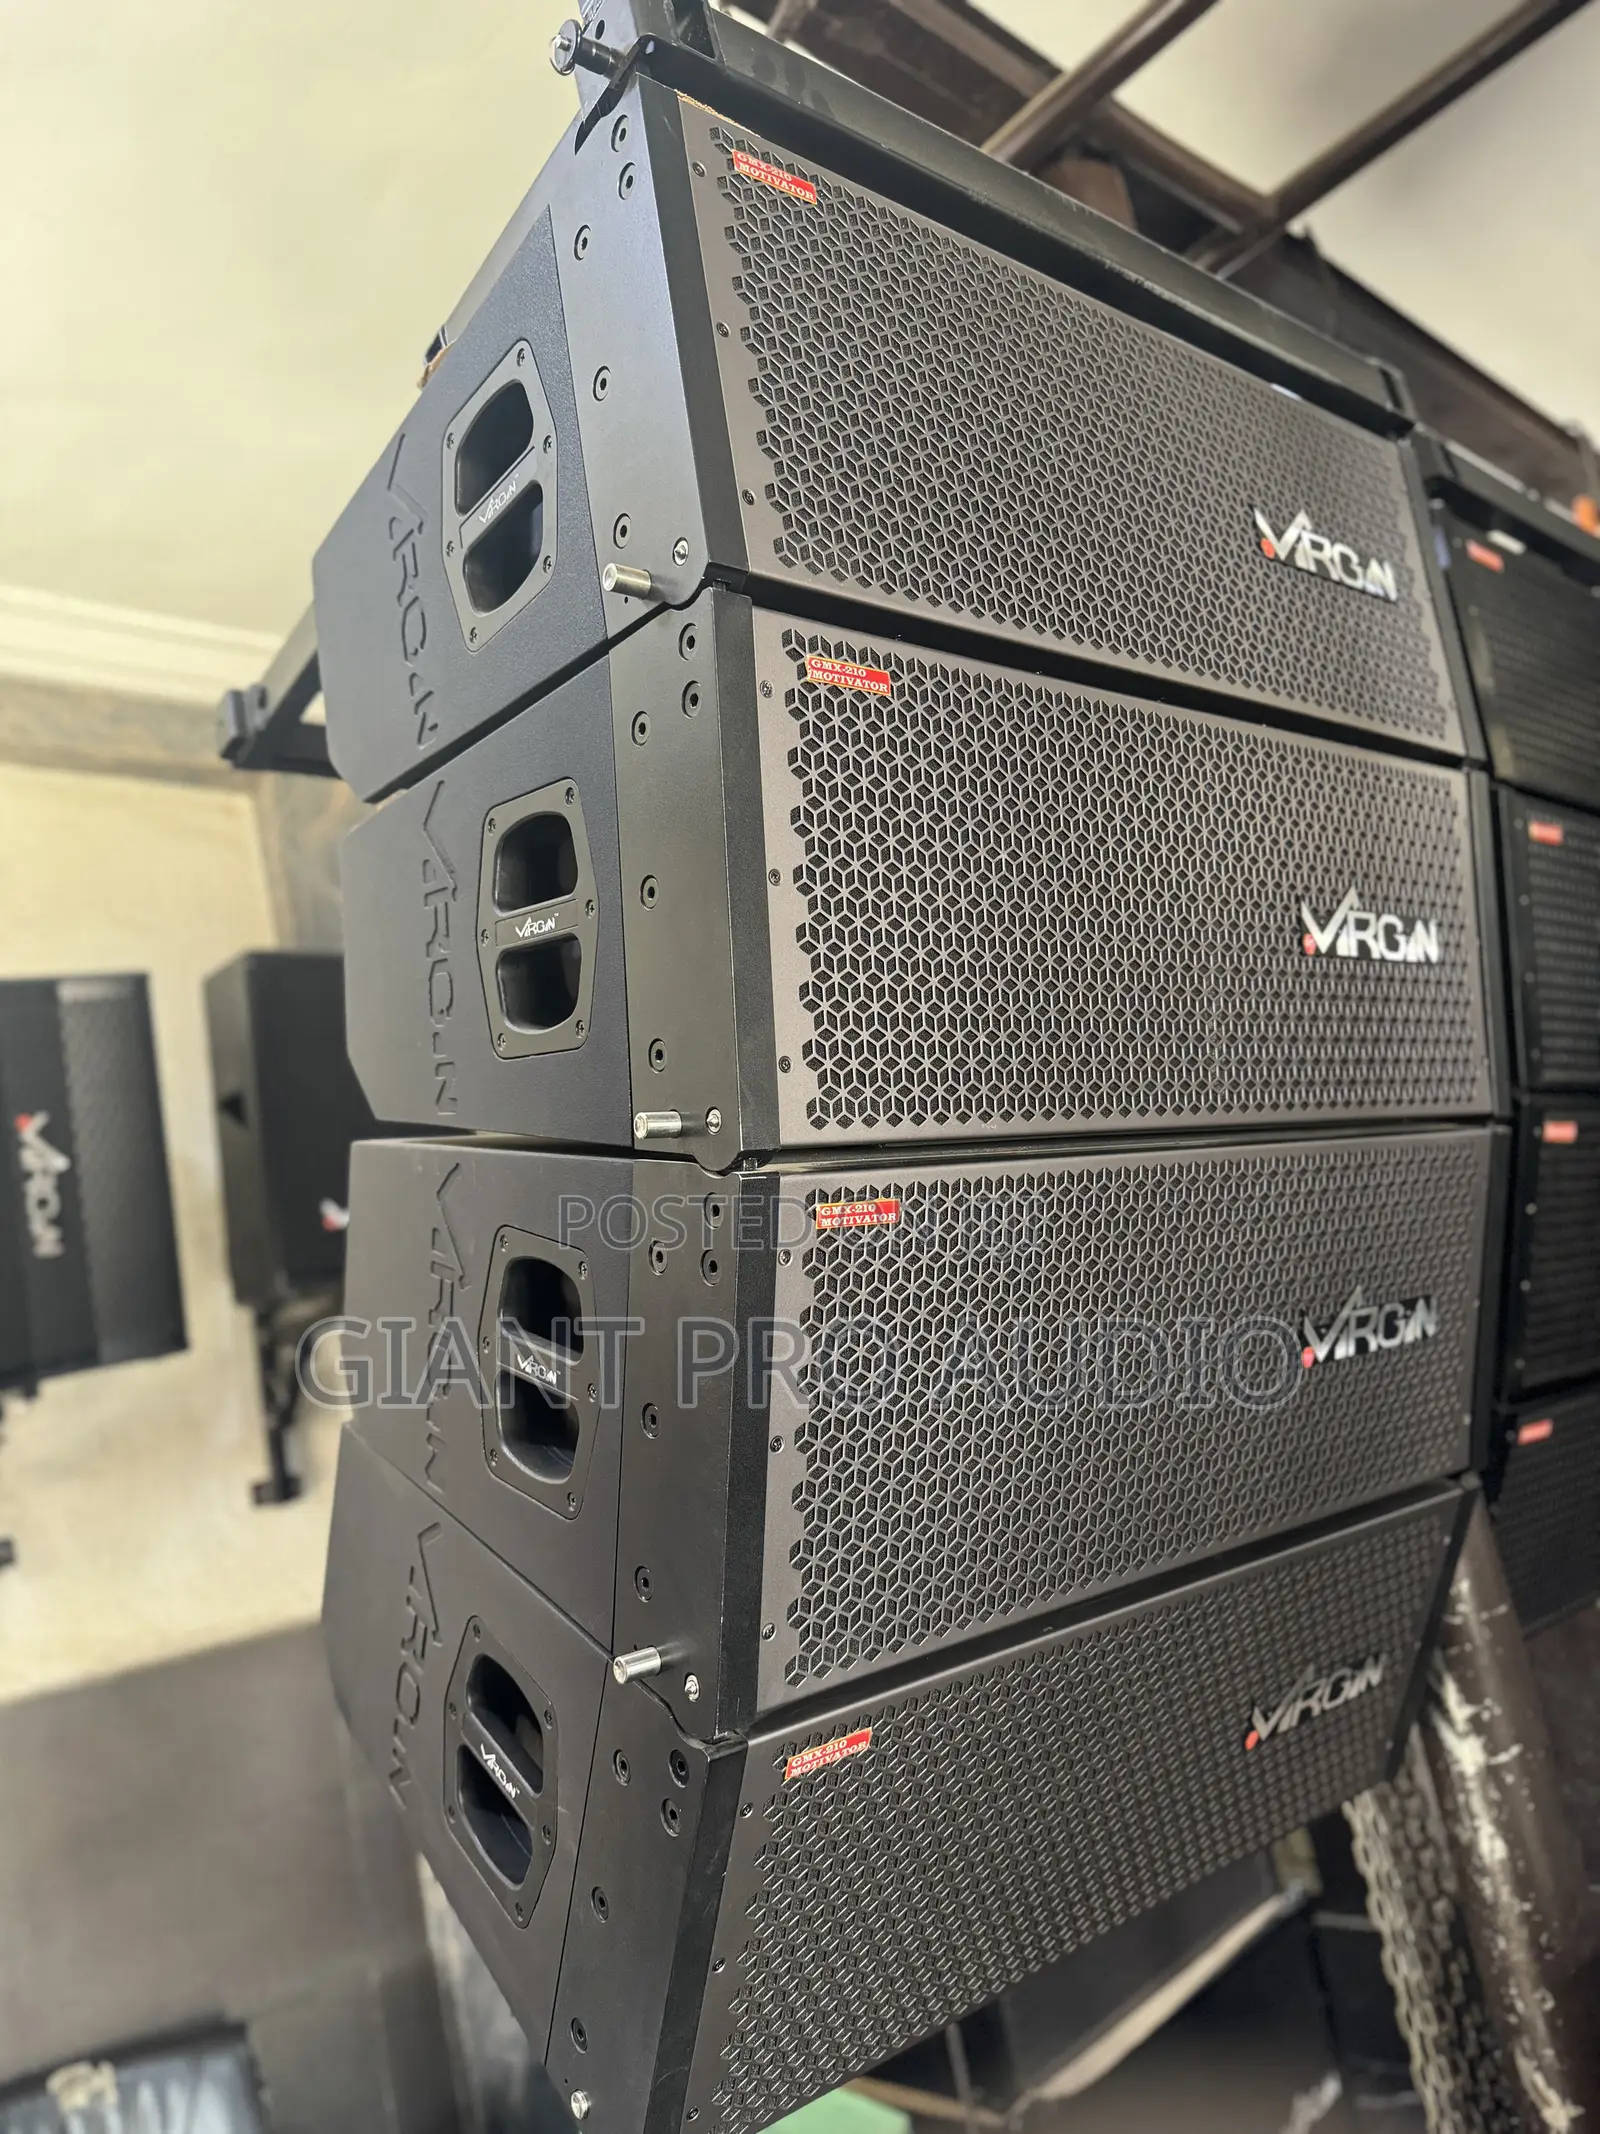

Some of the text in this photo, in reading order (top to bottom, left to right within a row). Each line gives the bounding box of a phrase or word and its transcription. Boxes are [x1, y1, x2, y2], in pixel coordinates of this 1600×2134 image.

[737, 153, 792, 182] GMX-210
[738, 162, 815, 201] MOTIVATOR
[811, 659, 867, 678] GMX-210
[812, 670, 889, 693] MOTIVATOR
[1301, 885, 1439, 964] VIRGIN
[821, 1203, 877, 1217] GMX-210
[821, 1213, 897, 1227] MOTIVATOR
[789, 1741, 868, 1777] MOTIVATOR
[791, 1740, 848, 1768] GMX-210
